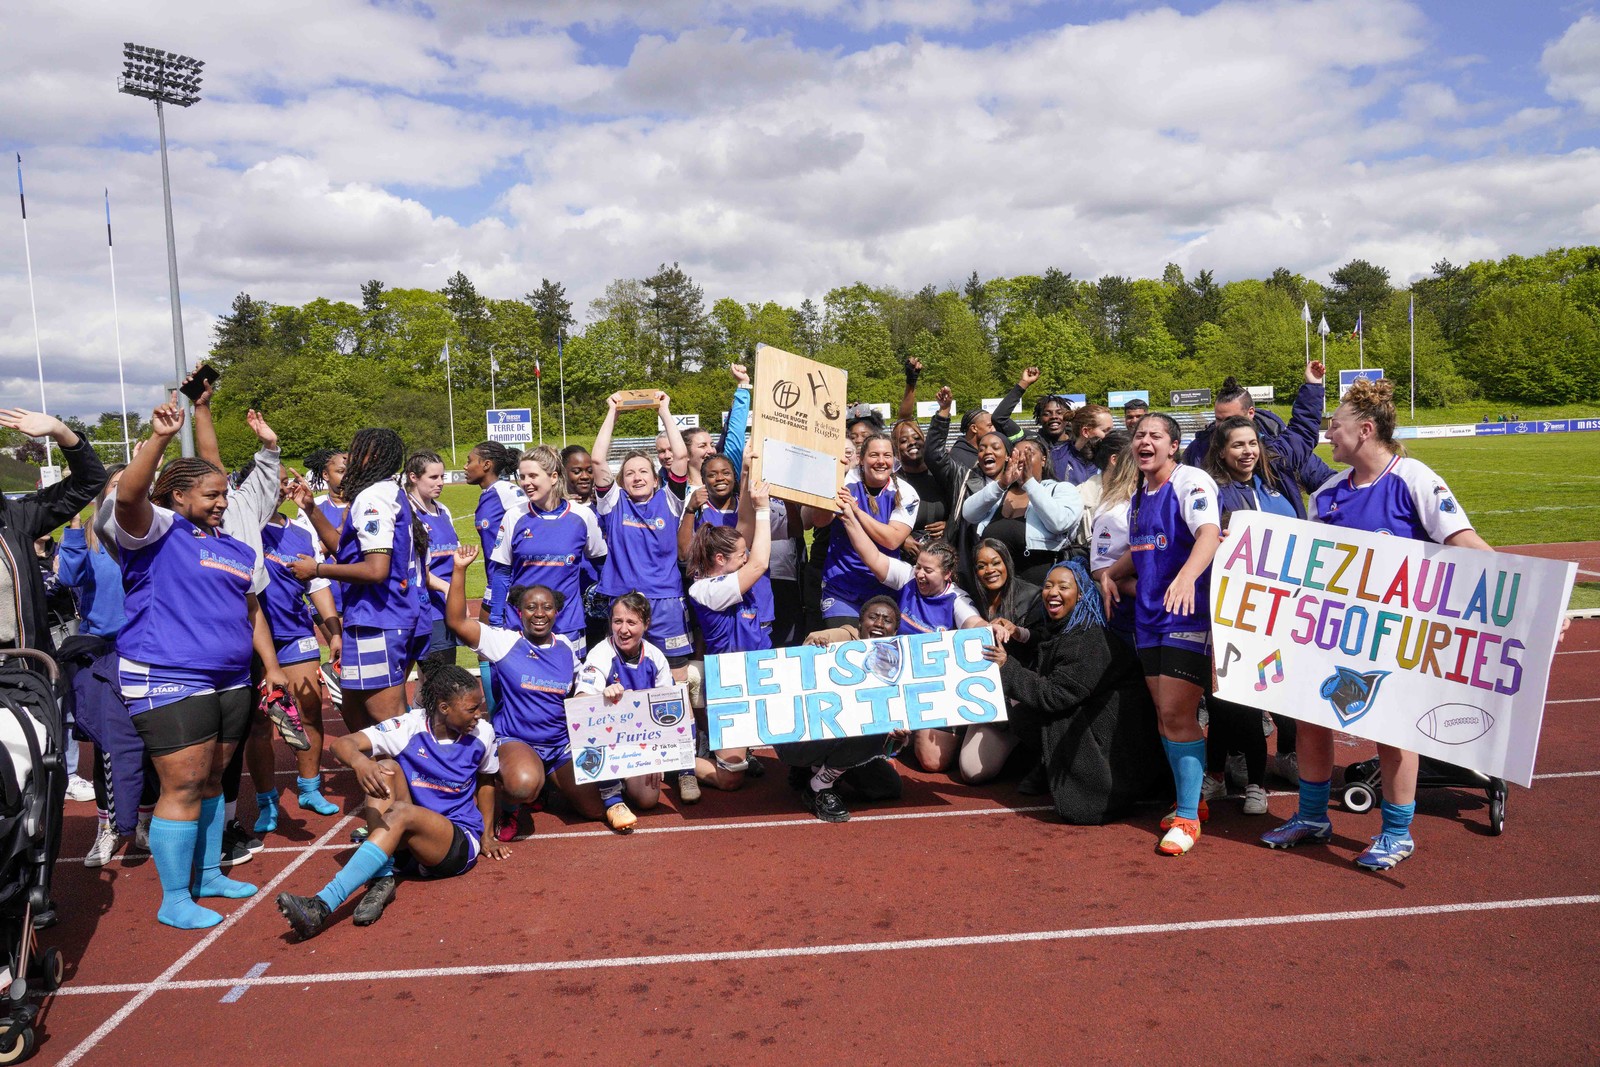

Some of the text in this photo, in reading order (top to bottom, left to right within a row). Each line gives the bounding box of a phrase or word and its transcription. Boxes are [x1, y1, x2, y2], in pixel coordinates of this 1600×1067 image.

[761, 413, 808, 431] HAUTS-DE-FRANCE
[774, 411, 808, 425] LIGUE RUGBY
[493, 423, 526, 432] TERRE DE
[814, 427, 840, 440] Rugby
[489, 433, 531, 441] CHAMPIONS
[1224, 525, 1521, 627] ALLEZ LAULAU
[1214, 576, 1526, 696] LET'S GO FURIES
[704, 627, 996, 700] LET'S GO
[588, 712, 634, 727] Let's go
[707, 676, 998, 751] FURIES
[615, 729, 662, 744] Furies
[608, 753, 621, 761] Tous
[635, 760, 652, 768] Furies
